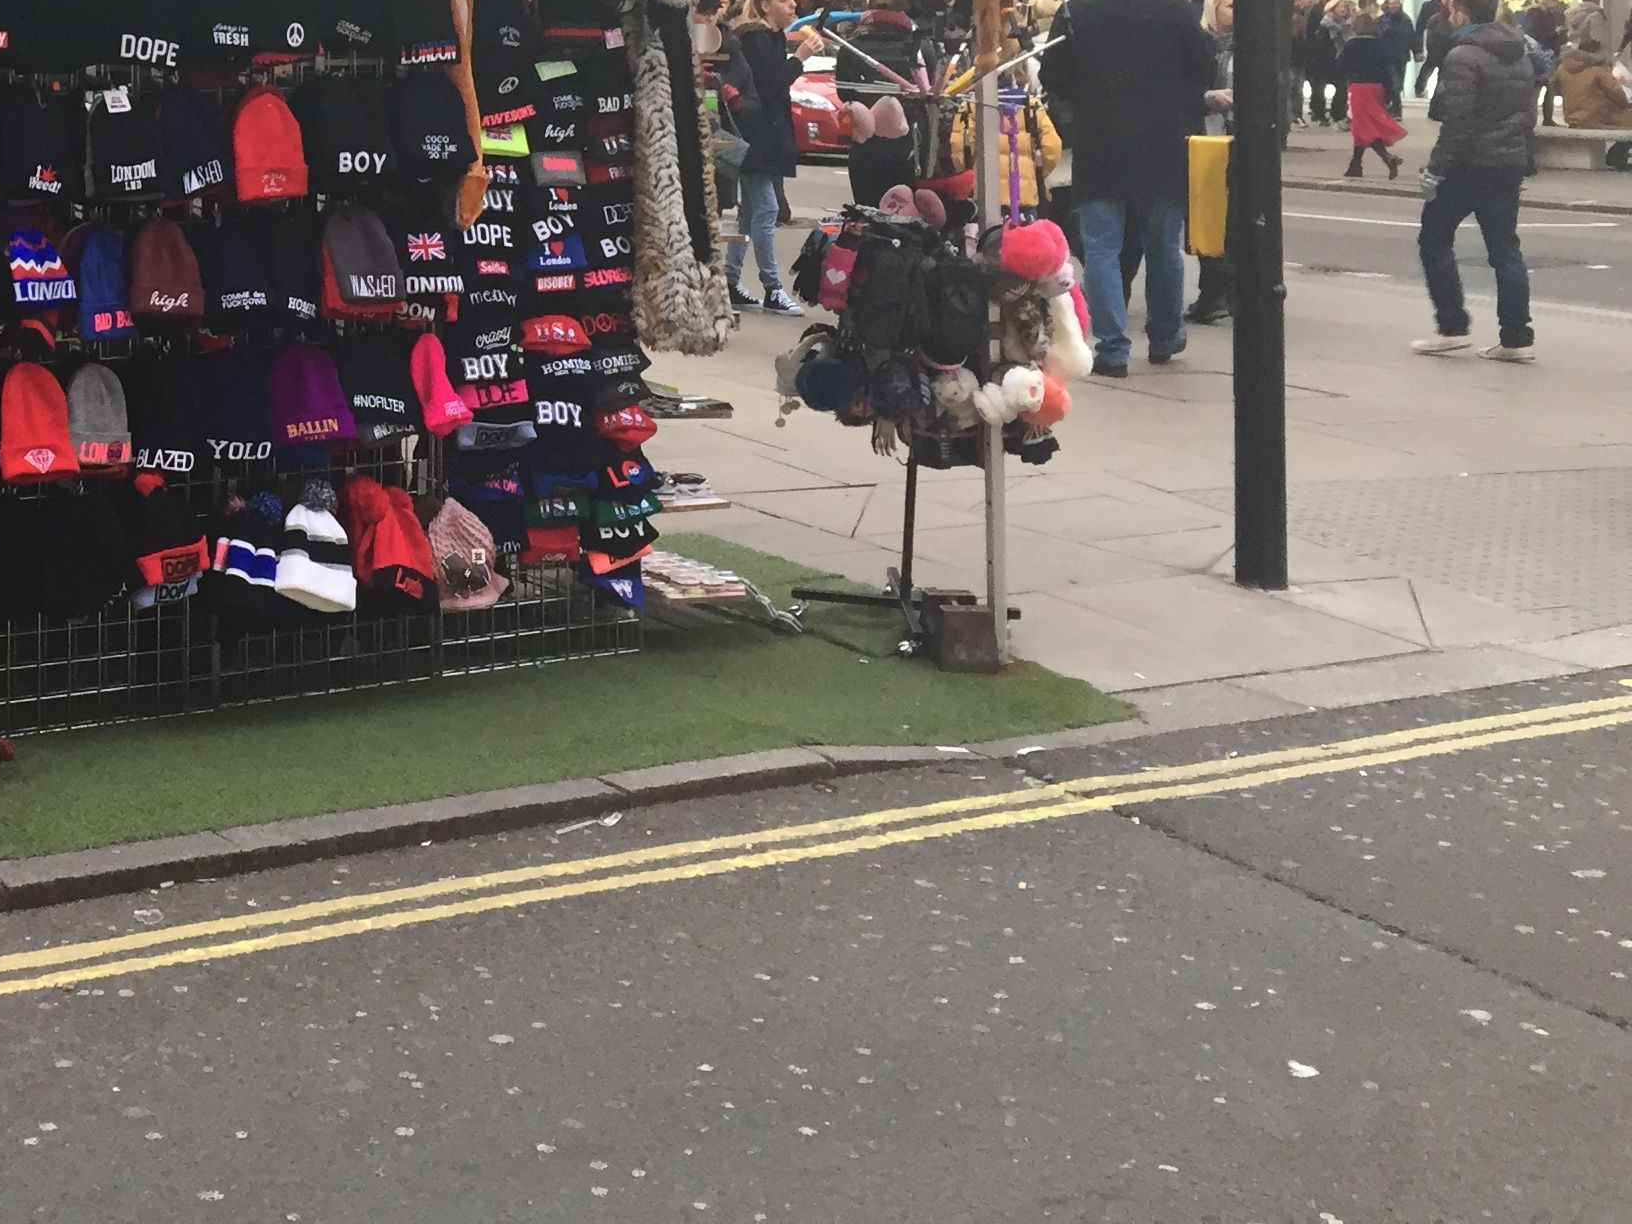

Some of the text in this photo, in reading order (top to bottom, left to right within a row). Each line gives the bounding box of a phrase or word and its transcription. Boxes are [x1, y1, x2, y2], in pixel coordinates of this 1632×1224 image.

[120, 33, 180, 67] DOPE
[213, 32, 249, 46] FRESH
[401, 39, 457, 65] LONDON
[481, 104, 537, 127] AWESOME
[597, 96, 620, 113] BAD
[425, 135, 450, 144] COCO
[544, 123, 576, 143] high
[37, 164, 42, 177] I
[111, 159, 156, 184] LONDON
[338, 150, 386, 174] BOY
[28, 176, 62, 194] Weed!
[549, 188, 558, 201] I
[549, 201, 578, 211] London
[462, 223, 514, 248] DOPE
[532, 213, 575, 242] BOY
[544, 243, 551, 256] I
[600, 235, 632, 259] BO
[539, 255, 572, 266] London
[536, 275, 574, 292] DISOBEY
[150, 290, 189, 313] high
[475, 326, 512, 350] crazy
[534, 321, 579, 344] USA
[462, 353, 509, 381] BOY
[541, 357, 592, 375] HOMIES
[593, 353, 640, 371] HOMIES
[353, 394, 405, 415] #NOFILTER
[534, 401, 582, 428] BOY
[287, 418, 338, 438] BALLIN
[136, 449, 195, 472] BLAZED
[206, 438, 272, 461] YOLO
[538, 498, 579, 520] USA
